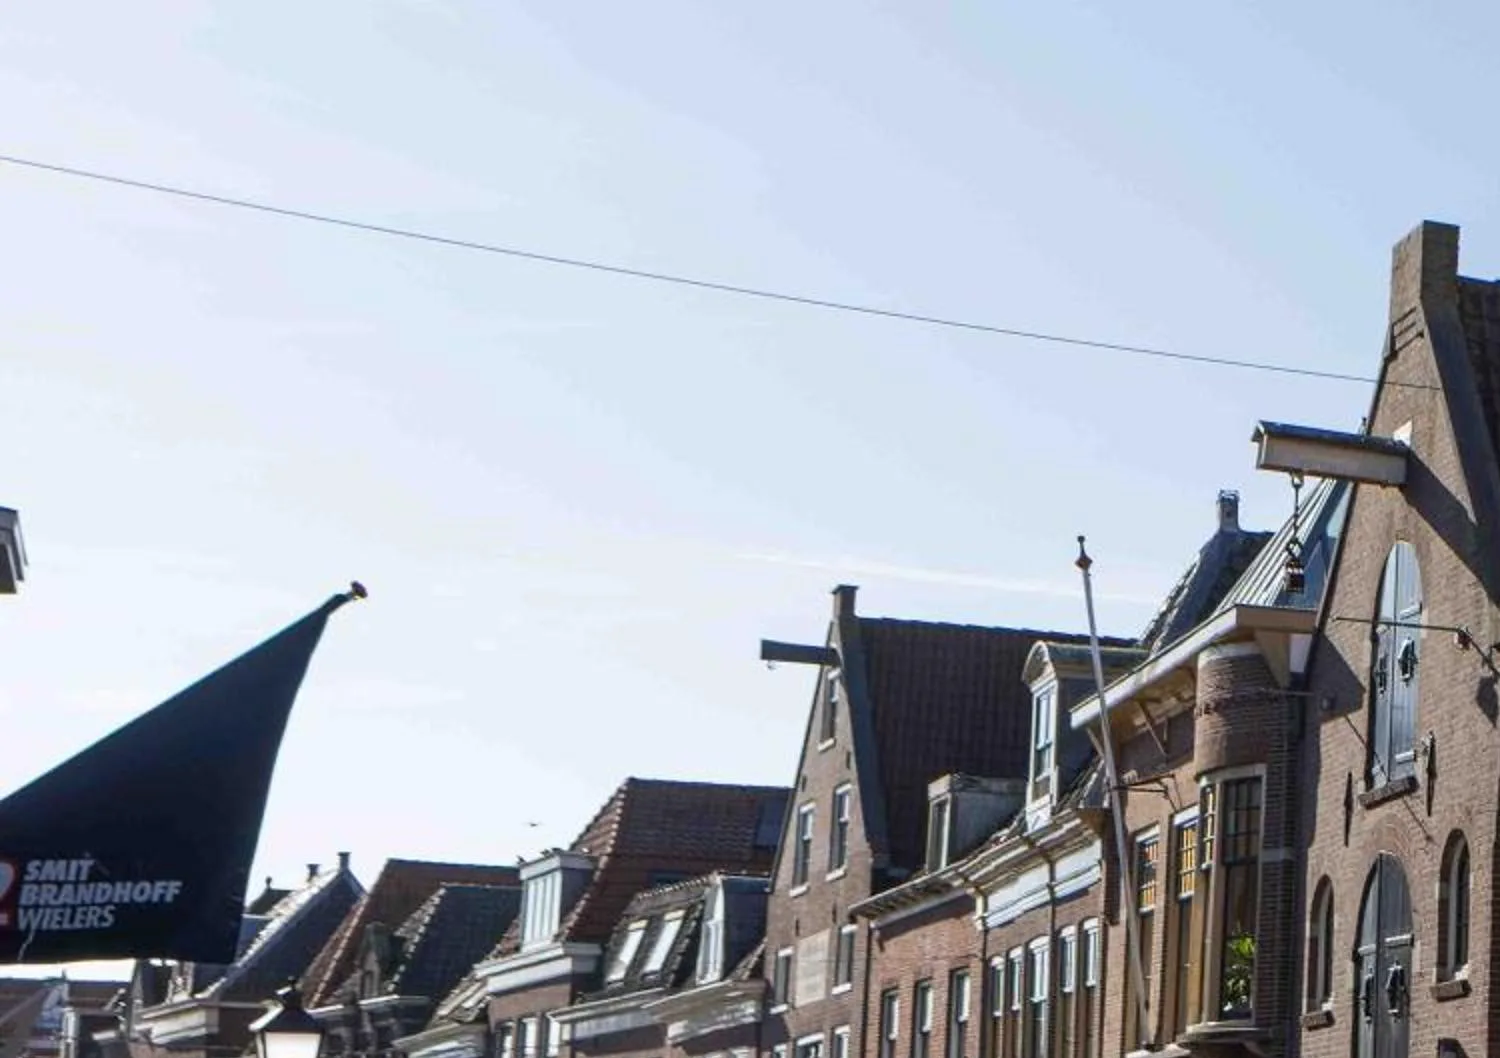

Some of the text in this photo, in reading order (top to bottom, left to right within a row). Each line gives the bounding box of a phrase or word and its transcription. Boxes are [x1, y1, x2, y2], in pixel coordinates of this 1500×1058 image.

[24, 858, 96, 882] SMIT
[18, 881, 183, 906] BRANDHOFF
[17, 904, 116, 931] WIELERS
